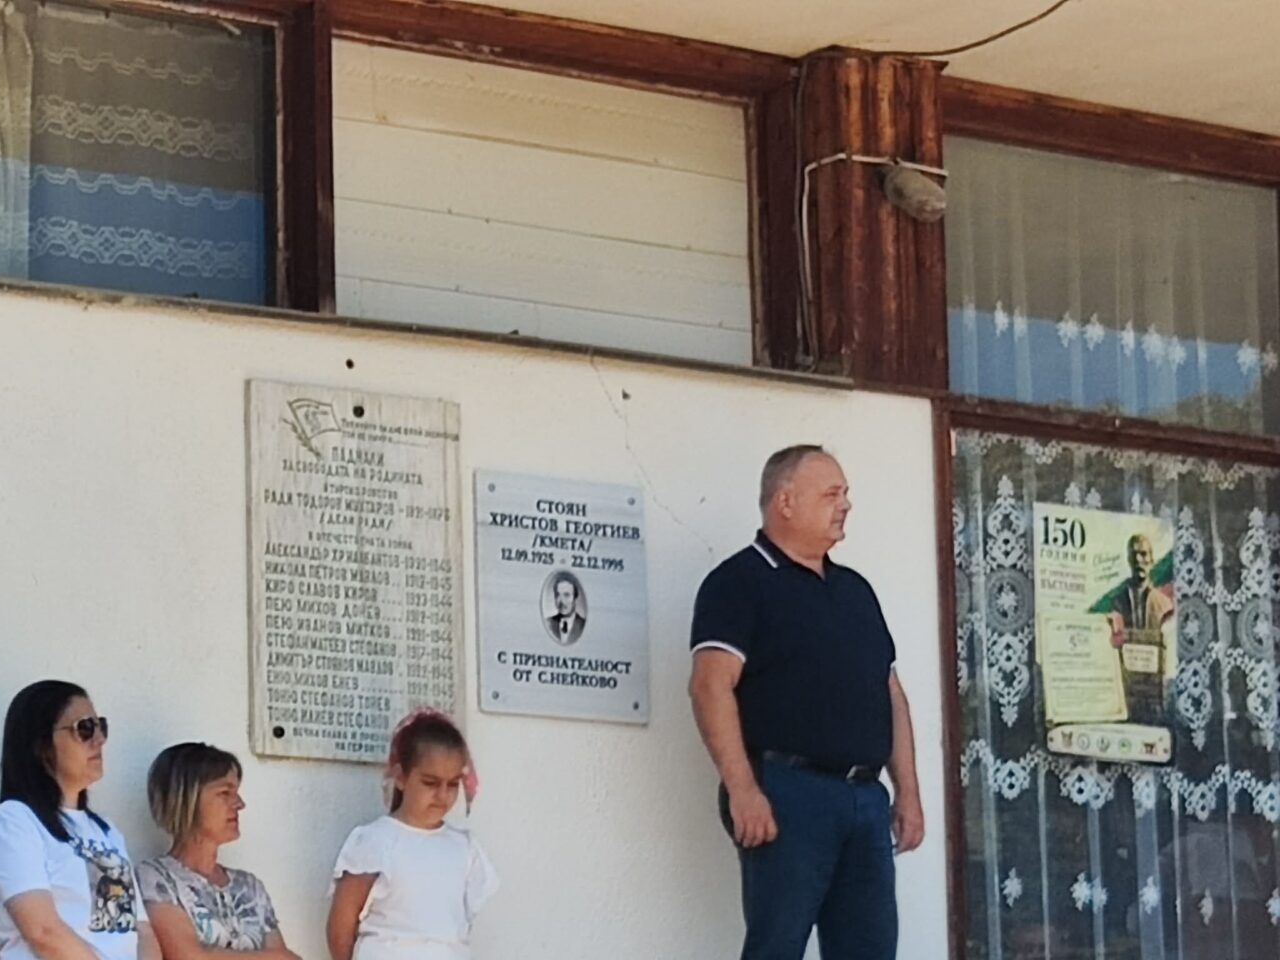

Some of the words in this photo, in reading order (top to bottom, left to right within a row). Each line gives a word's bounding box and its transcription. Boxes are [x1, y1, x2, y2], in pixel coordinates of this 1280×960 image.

[536, 499, 587, 516] СТОЯН
[489, 512, 558, 532] ХРИСТОВ
[566, 521, 640, 539] ГЕОРГИЕВ
[1042, 516, 1086, 549] 150
[532, 534, 593, 553] /КМЕТА/
[498, 652, 507, 663] С
[513, 652, 631, 674] ПРИЗНАТЕЛНОСТ
[513, 670, 532, 682] ОТ
[538, 669, 618, 689] С.НЕЙКОВО
